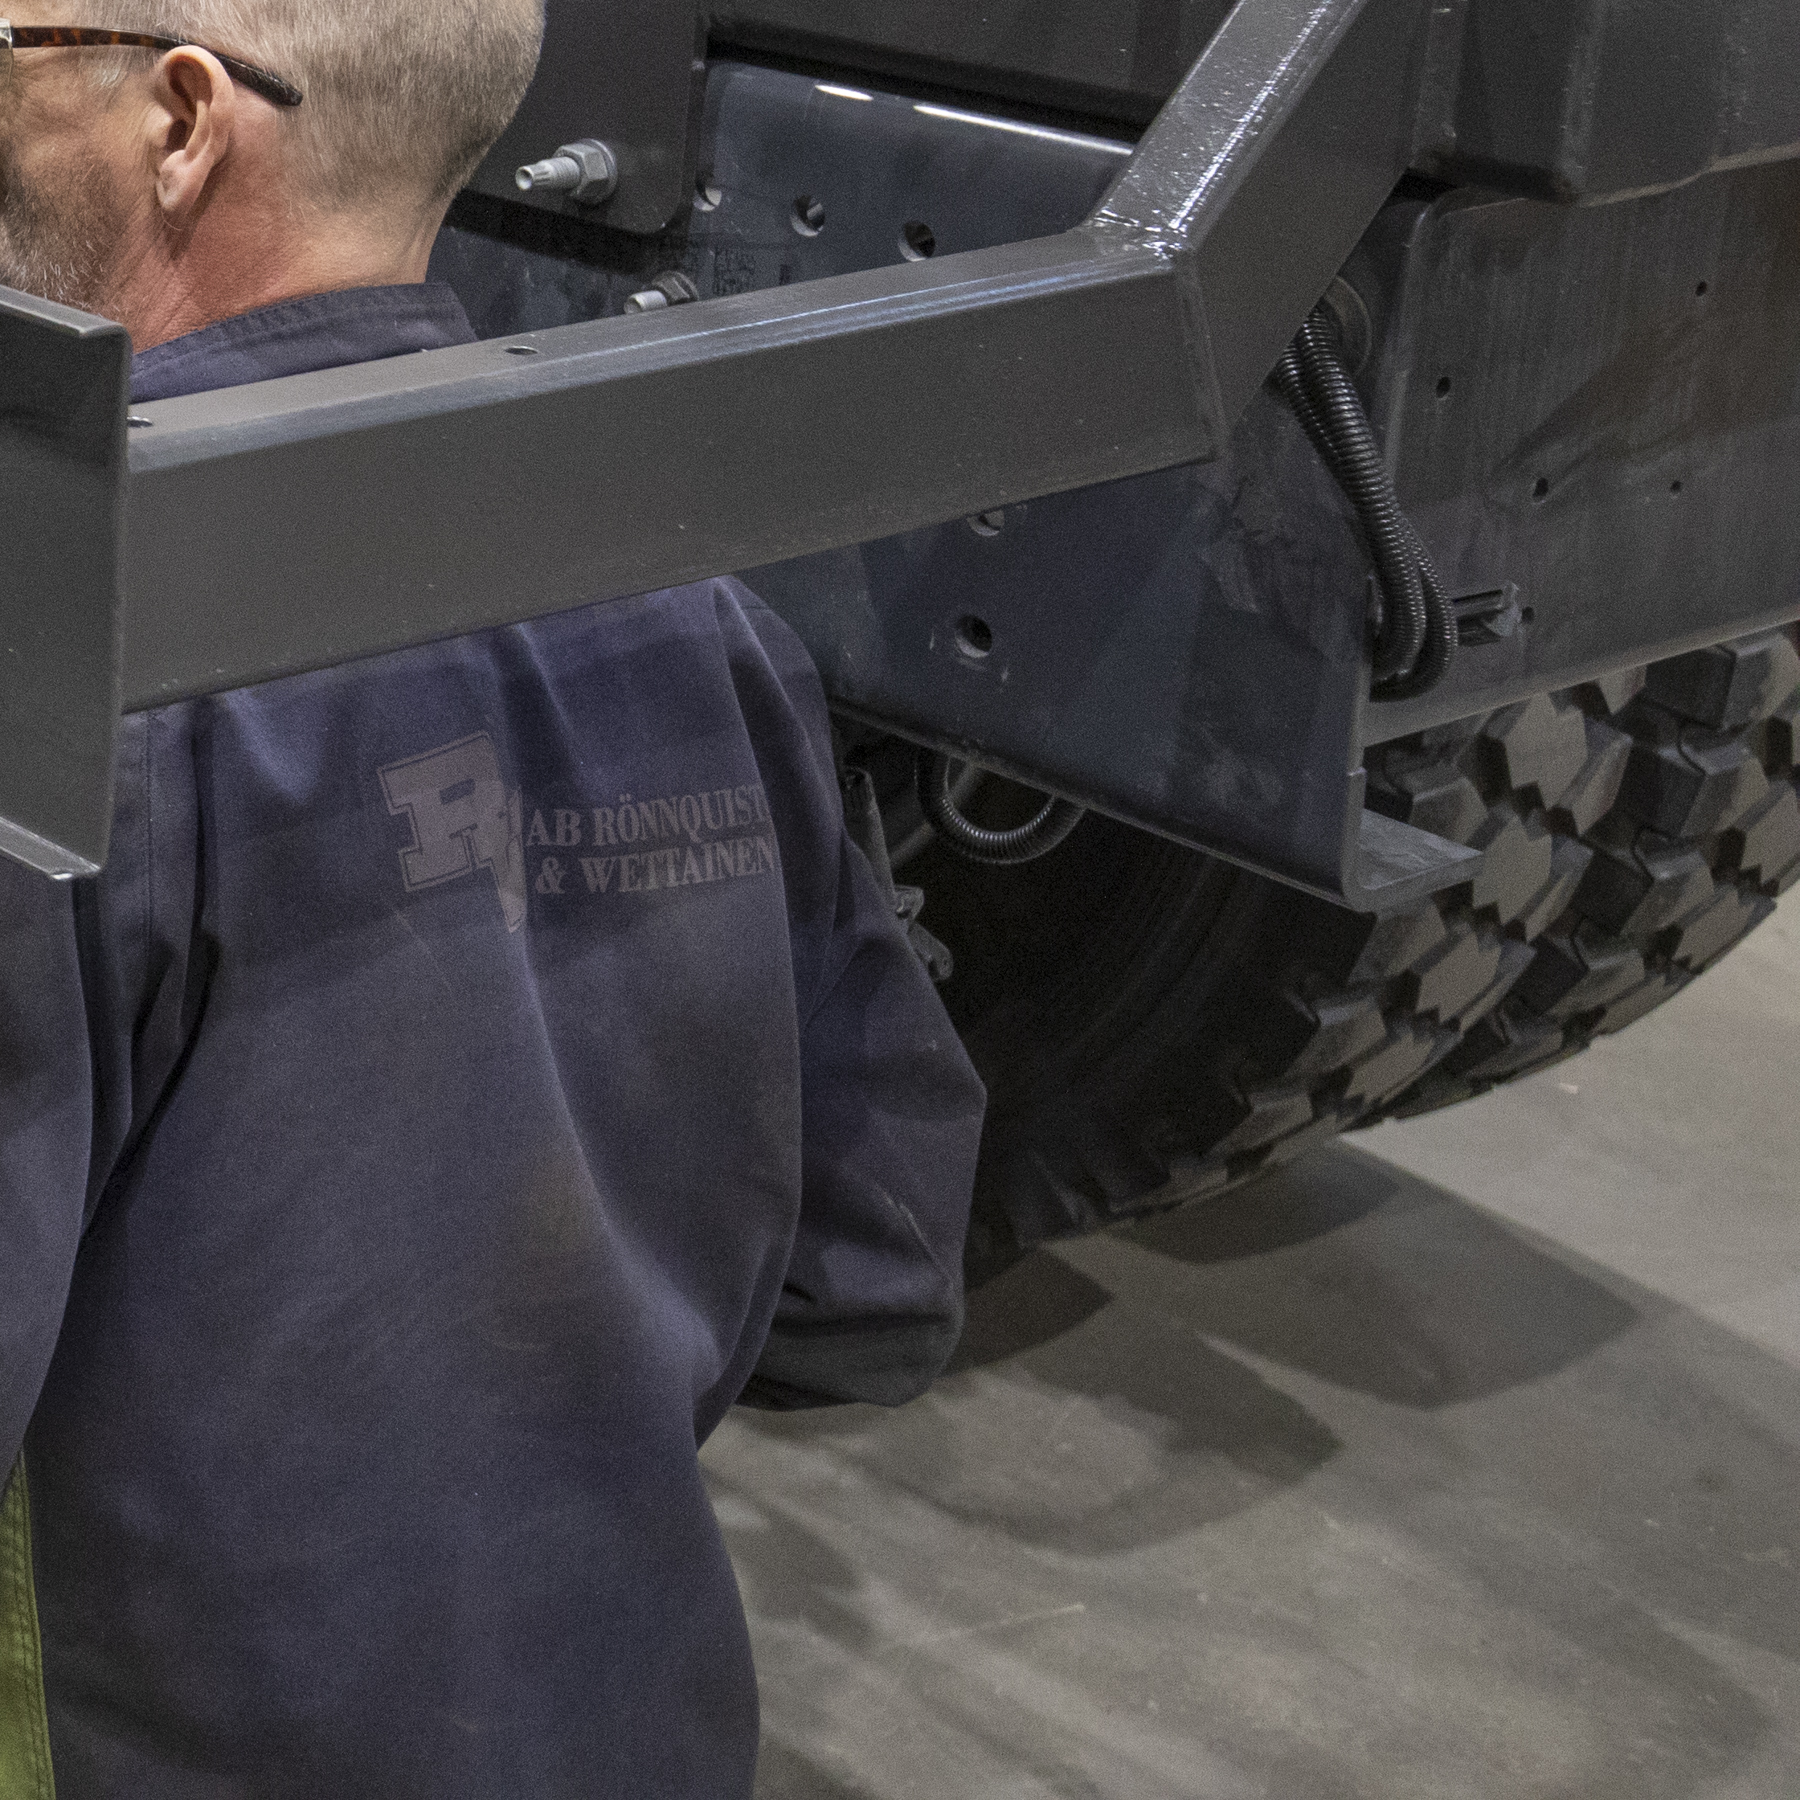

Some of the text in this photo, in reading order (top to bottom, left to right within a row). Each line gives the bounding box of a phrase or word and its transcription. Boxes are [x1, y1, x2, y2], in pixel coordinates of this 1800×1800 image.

[526, 784, 770, 847] AB RÖNNQUIST
[534, 835, 777, 894] & WETTAINEN
